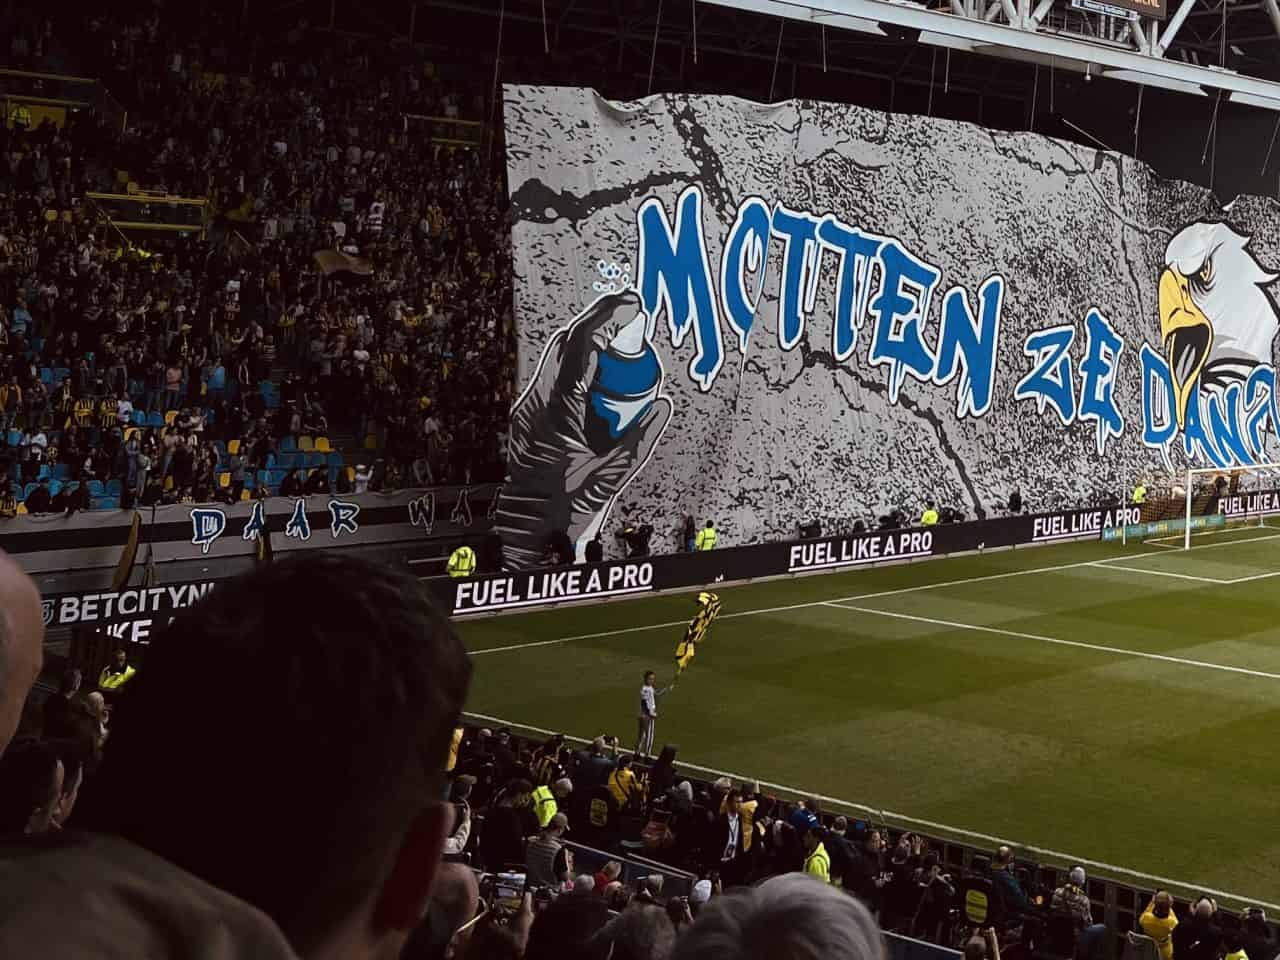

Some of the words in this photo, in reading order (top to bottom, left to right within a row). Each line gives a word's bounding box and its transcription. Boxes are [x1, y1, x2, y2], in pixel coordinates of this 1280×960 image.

[637, 186, 1005, 419] MOTTEN
[1014, 307, 1124, 453] ZE
[1218, 497, 1245, 514] FUEL
[1247, 494, 1270, 511] LIKE
[1272, 493, 1280, 508] A
[1033, 516, 1069, 537] FUEL
[1072, 511, 1101, 532] LIKE
[1103, 510, 1113, 527] A
[1116, 507, 1141, 525] PRO
[789, 542, 838, 567] FUEL
[841, 537, 881, 560] LIKE
[884, 535, 896, 555] A
[900, 531, 933, 553] PRO
[455, 576, 521, 608] FUEL
[527, 571, 582, 600] LIKE
[585, 568, 602, 593] A
[608, 563, 653, 589] PRO
